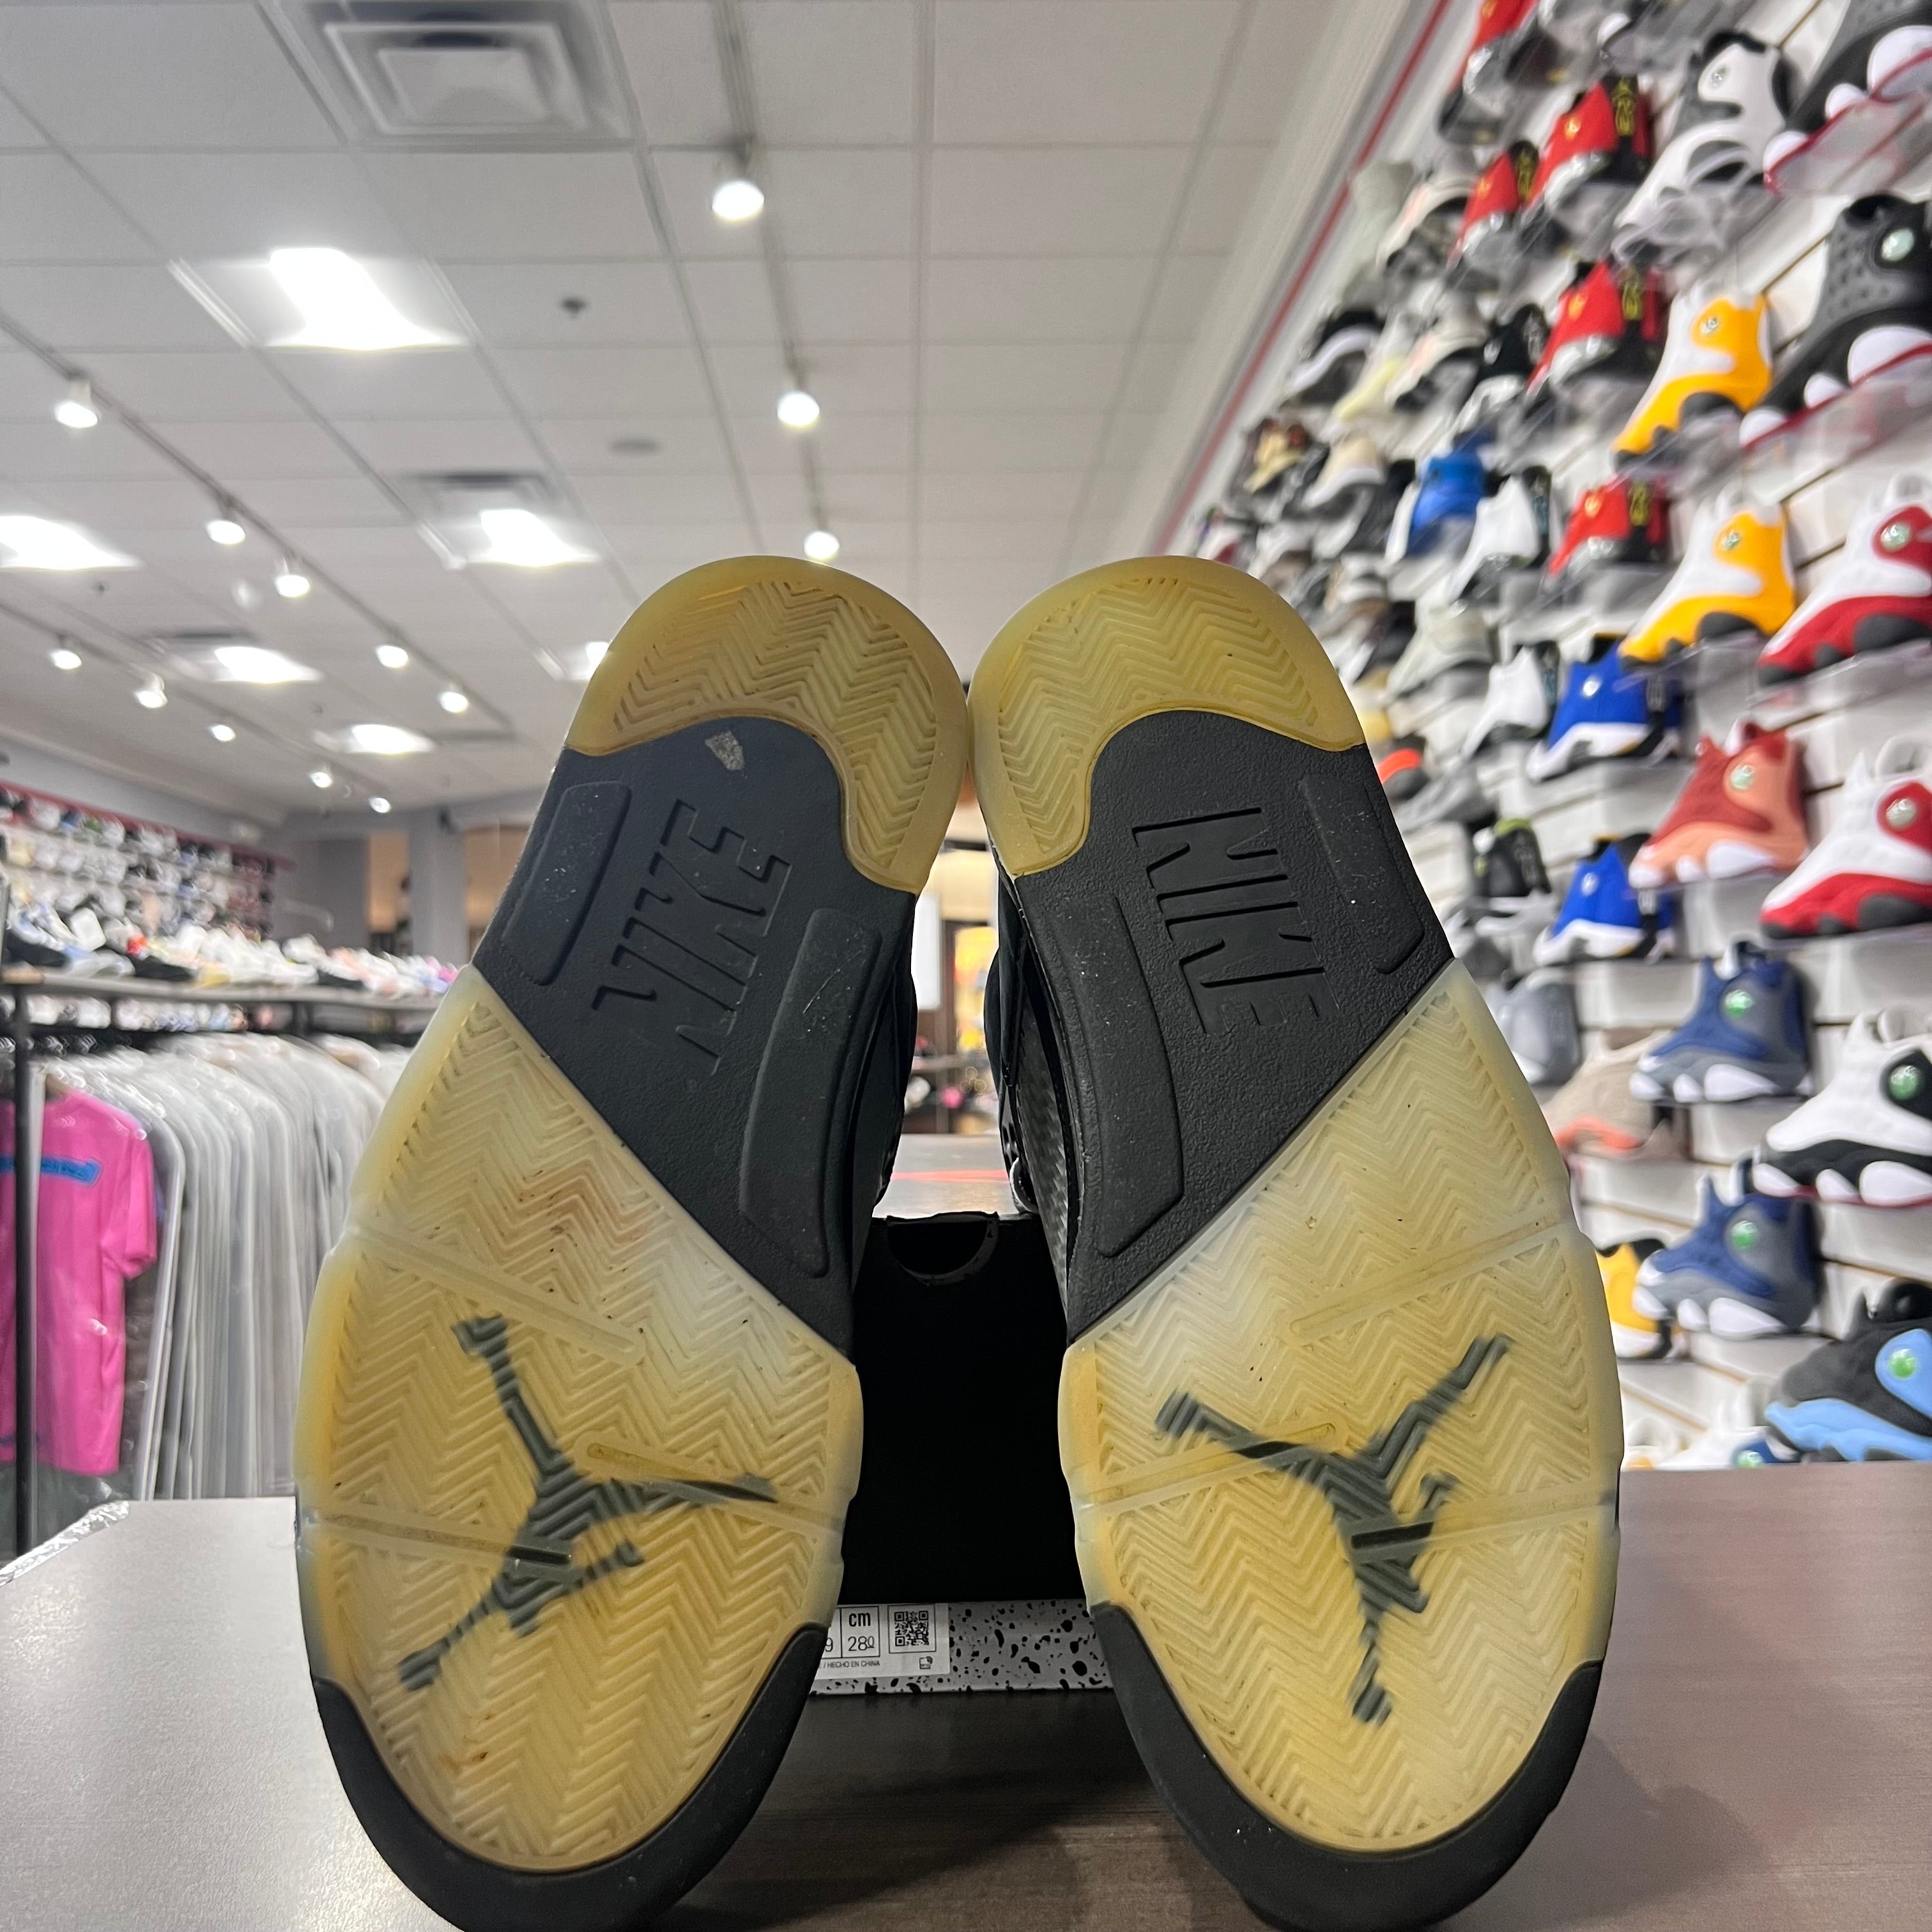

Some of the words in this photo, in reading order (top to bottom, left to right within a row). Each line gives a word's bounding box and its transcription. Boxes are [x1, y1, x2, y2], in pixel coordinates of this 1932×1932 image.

[591, 799, 793, 1077] NIKE
[1132, 806, 1342, 1034] NIKE
[848, 1612, 871, 1627] cm
